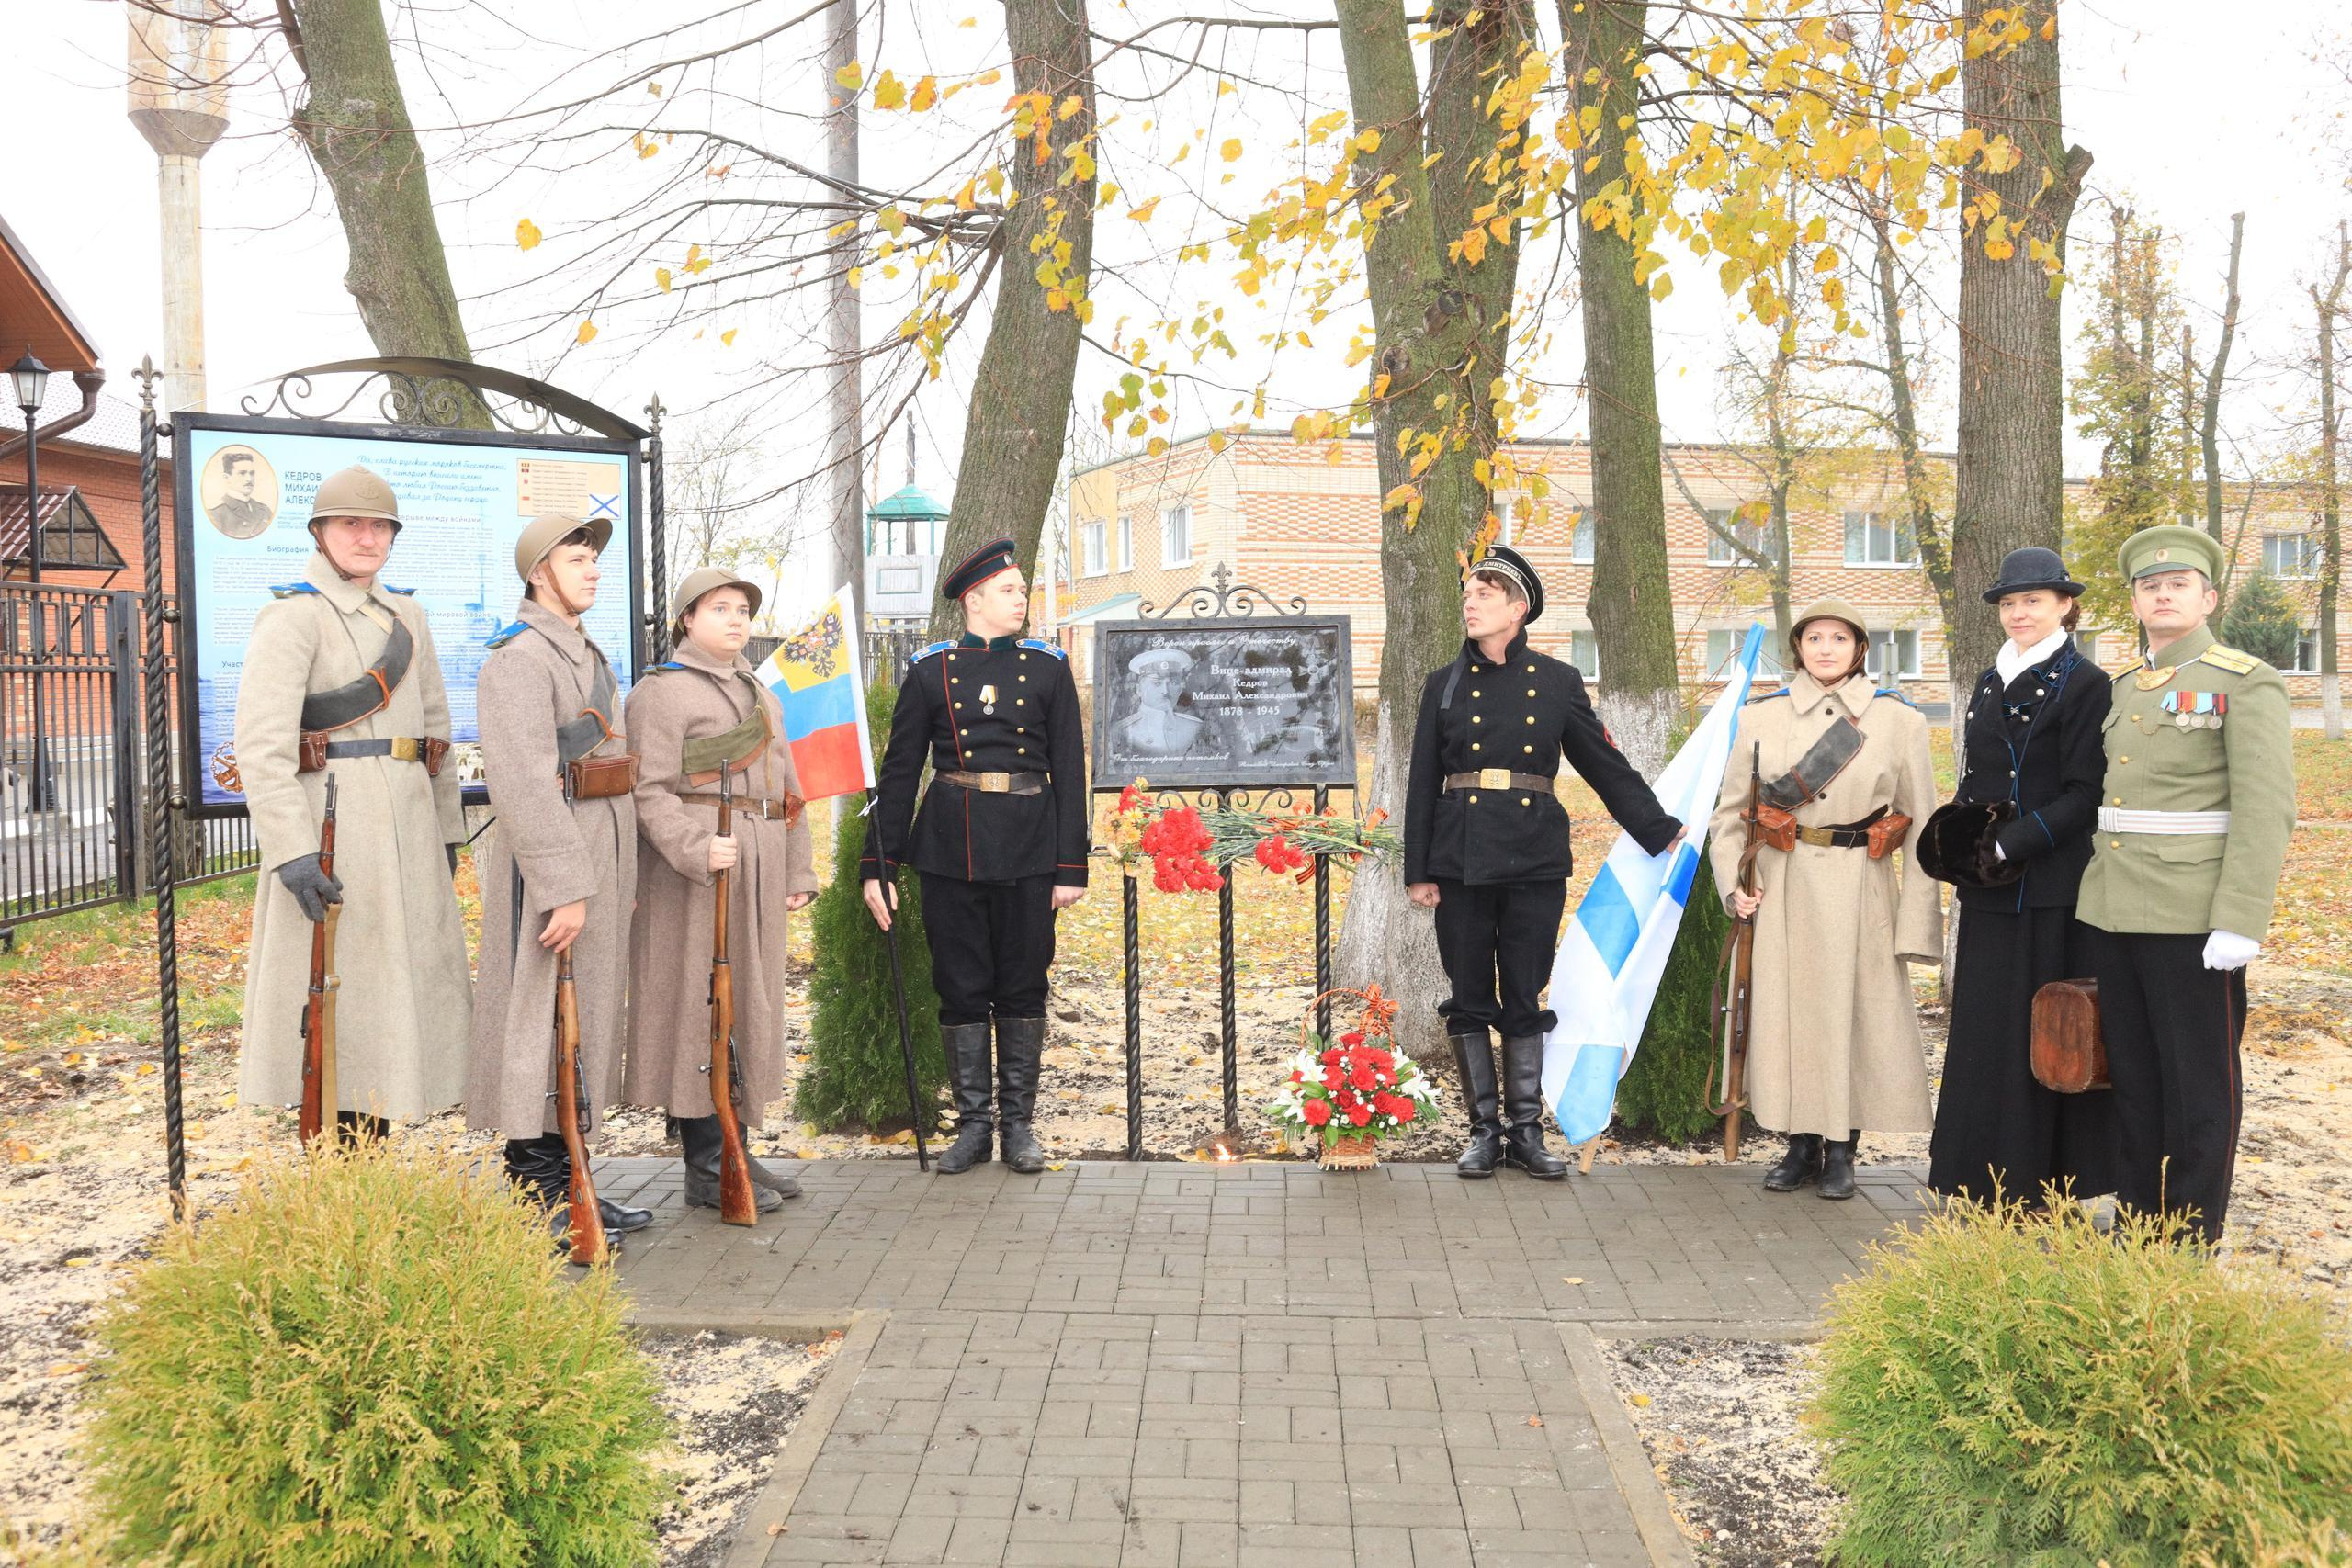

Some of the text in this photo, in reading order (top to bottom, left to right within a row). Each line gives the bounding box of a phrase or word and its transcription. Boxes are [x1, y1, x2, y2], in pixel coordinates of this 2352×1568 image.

[285, 471, 322, 482] КЕДРОВ
[285, 483, 320, 493] МИХАИ
[285, 496, 316, 505] АЛЕКС
[266, 545, 310, 554] Биография
[221, 660, 243, 669] Участ
[1210, 664, 1293, 677] Вице-адмирал
[1233, 678, 1269, 688] Кедров
[1193, 690, 1309, 701] Михаил Александрович
[1219, 706, 1243, 716] 1878
[1256, 705, 1280, 716] 1945
